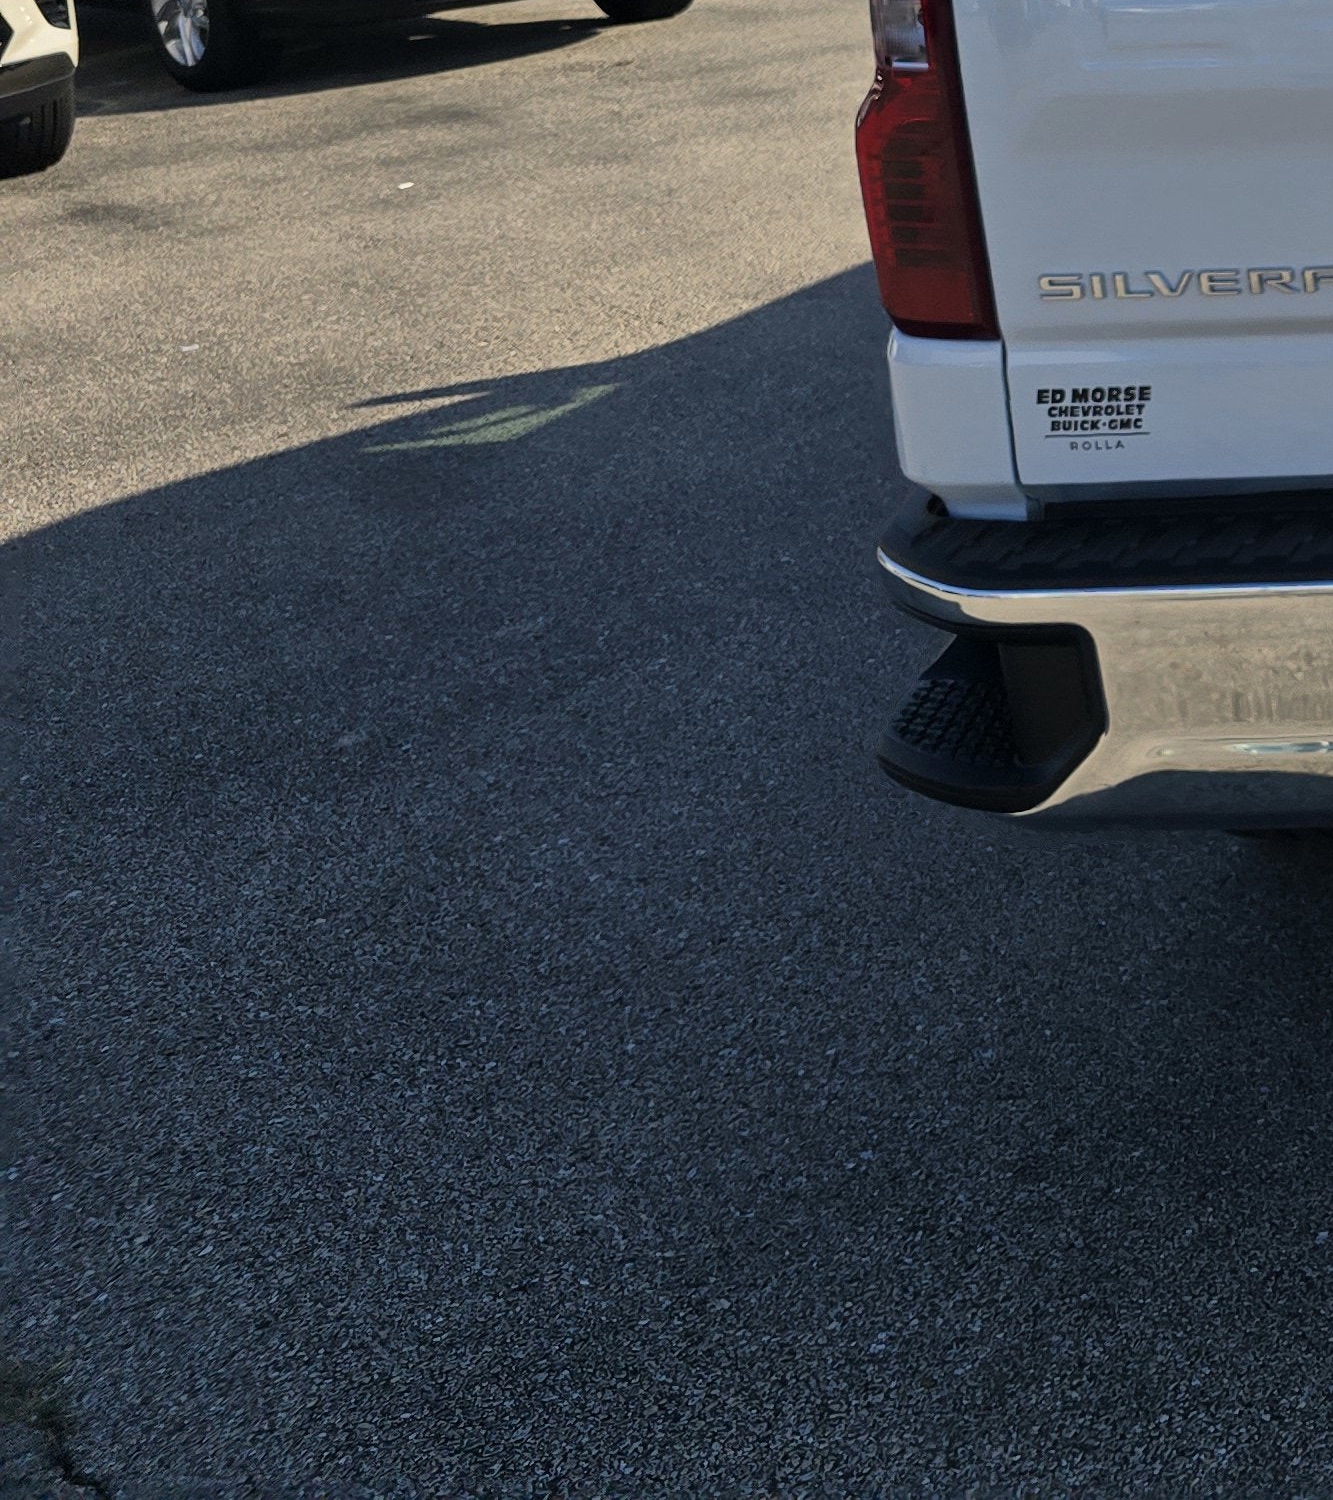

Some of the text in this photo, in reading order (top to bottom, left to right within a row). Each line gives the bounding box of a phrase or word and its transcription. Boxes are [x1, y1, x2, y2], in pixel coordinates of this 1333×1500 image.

[1036, 385, 1152, 404] ED MORSE
[1047, 403, 1146, 417] CHEVROLET
[1070, 439, 1125, 451] ROLLA
